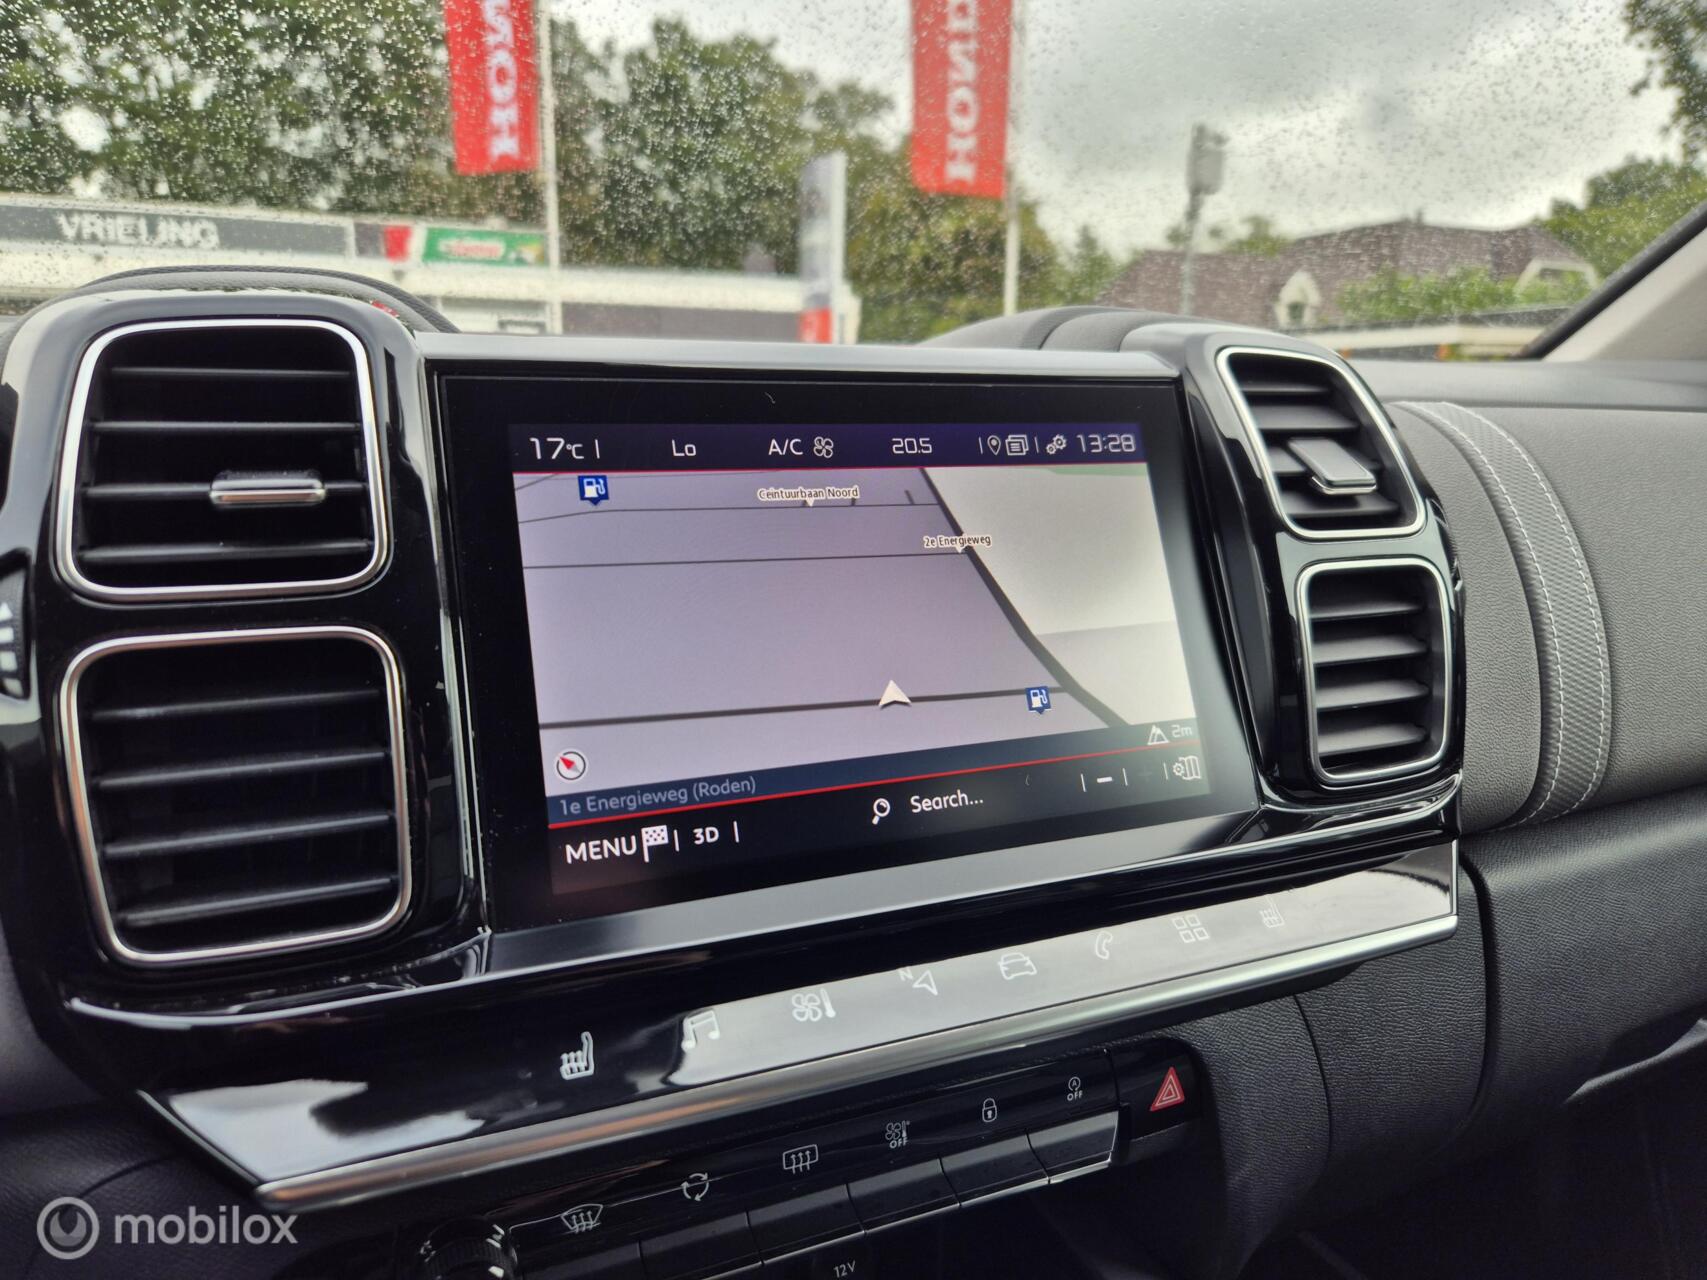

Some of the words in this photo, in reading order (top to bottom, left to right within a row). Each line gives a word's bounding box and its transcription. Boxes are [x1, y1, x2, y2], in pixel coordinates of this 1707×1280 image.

[55, 210, 220, 249] VRIELING
[671, 439, 697, 457] Lo
[768, 438, 803, 456] A/C
[892, 437, 932, 455] 20.5
[1076, 434, 1136, 453] 13:28
[758, 487, 824, 501] Ceintuurbaan
[827, 486, 859, 499] Noord
[923, 536, 937, 548] 2e
[938, 534, 992, 549] Energieweg
[1171, 724, 1193, 738] 2m
[559, 799, 581, 816] 1e
[586, 787, 689, 812] Energieweg
[692, 775, 757, 801] (Roden)
[910, 789, 984, 814] Search...
[693, 826, 720, 845] 3D
[565, 835, 637, 864] MENU
[1066, 1090, 1083, 1101] OFF
[889, 1136, 908, 1149] OFF
[833, 1259, 856, 1278] 12V
